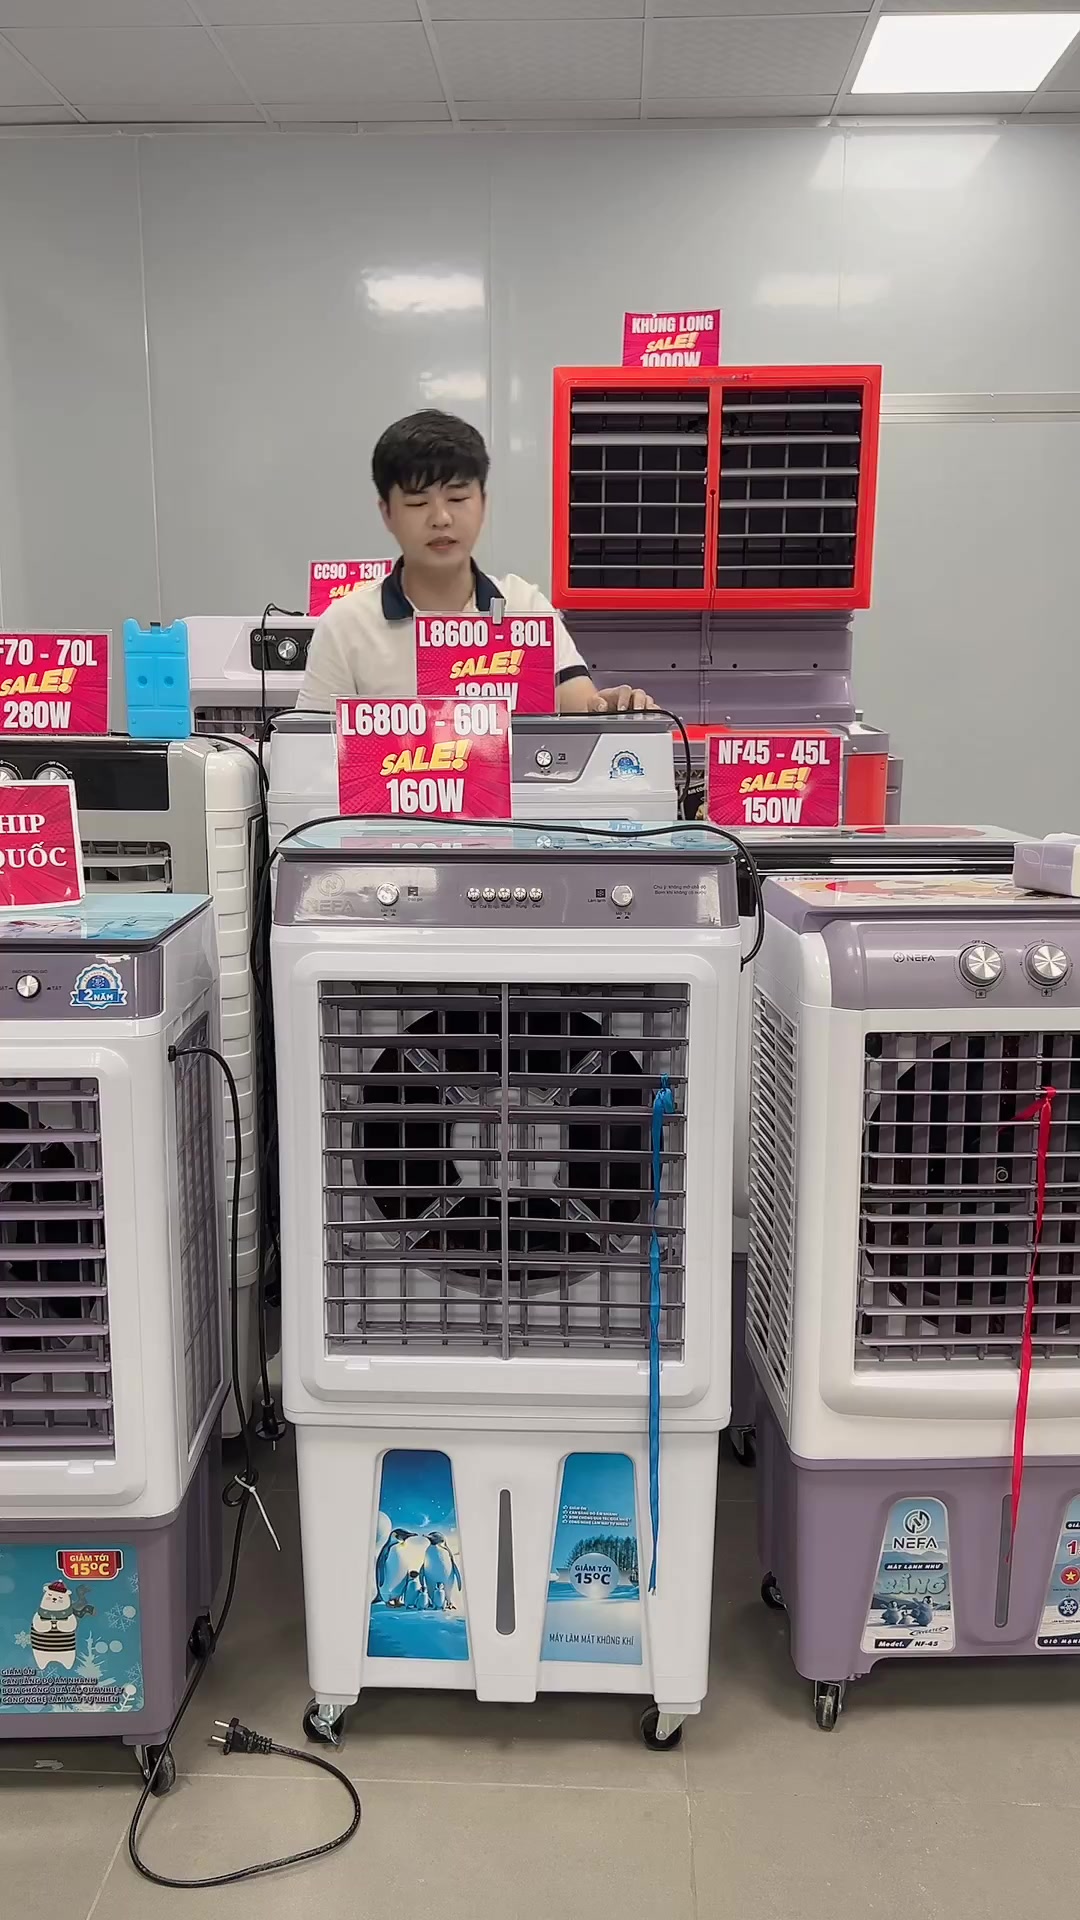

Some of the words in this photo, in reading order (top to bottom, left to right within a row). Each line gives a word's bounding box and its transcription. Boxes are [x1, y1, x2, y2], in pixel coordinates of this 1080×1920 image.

[631, 313, 676, 334] KHỦNG
[679, 314, 714, 332] LONG
[645, 331, 699, 353] SALE!
[640, 352, 701, 367] 1000W
[313, 563, 347, 580] CC90
[329, 580, 373, 598] SALE
[418, 620, 488, 648] L8600
[510, 620, 551, 647] 80L
[56, 639, 98, 667] 70L
[450, 649, 525, 679] SALE!
[0, 667, 78, 697] SALE!
[3, 700, 71, 729] 280W
[341, 703, 427, 736] L6800
[454, 703, 503, 736] 60L
[380, 739, 473, 776] SALE!
[718, 739, 770, 765] NF45
[790, 739, 831, 765] 45L
[738, 766, 812, 794] SALE!
[386, 778, 464, 814] 160W
[742, 796, 803, 824] 150W
[906, 954, 936, 962] NEFA
[83, 988, 93, 1001] 2
[94, 992, 114, 1001] NĂM
[892, 1536, 938, 1549] NEFA
[1067, 1540, 1080, 1556] 1
[69, 1553, 92, 1562] GIẢM
[94, 1553, 109, 1562] TỚI
[574, 1563, 596, 1572] GIẢM
[597, 1564, 612, 1573] TỚI
[886, 1562, 902, 1570] MÁT
[903, 1562, 923, 1571] LẠNH
[881, 1572, 946, 1595] BĂNG
[549, 1631, 564, 1643] MÁY
[565, 1632, 580, 1643] LÀM
[581, 1633, 595, 1644] MÁT
[596, 1634, 621, 1646] KHÔNG
[622, 1635, 634, 1646] KHÍ
[914, 1640, 939, 1648] NF-45
